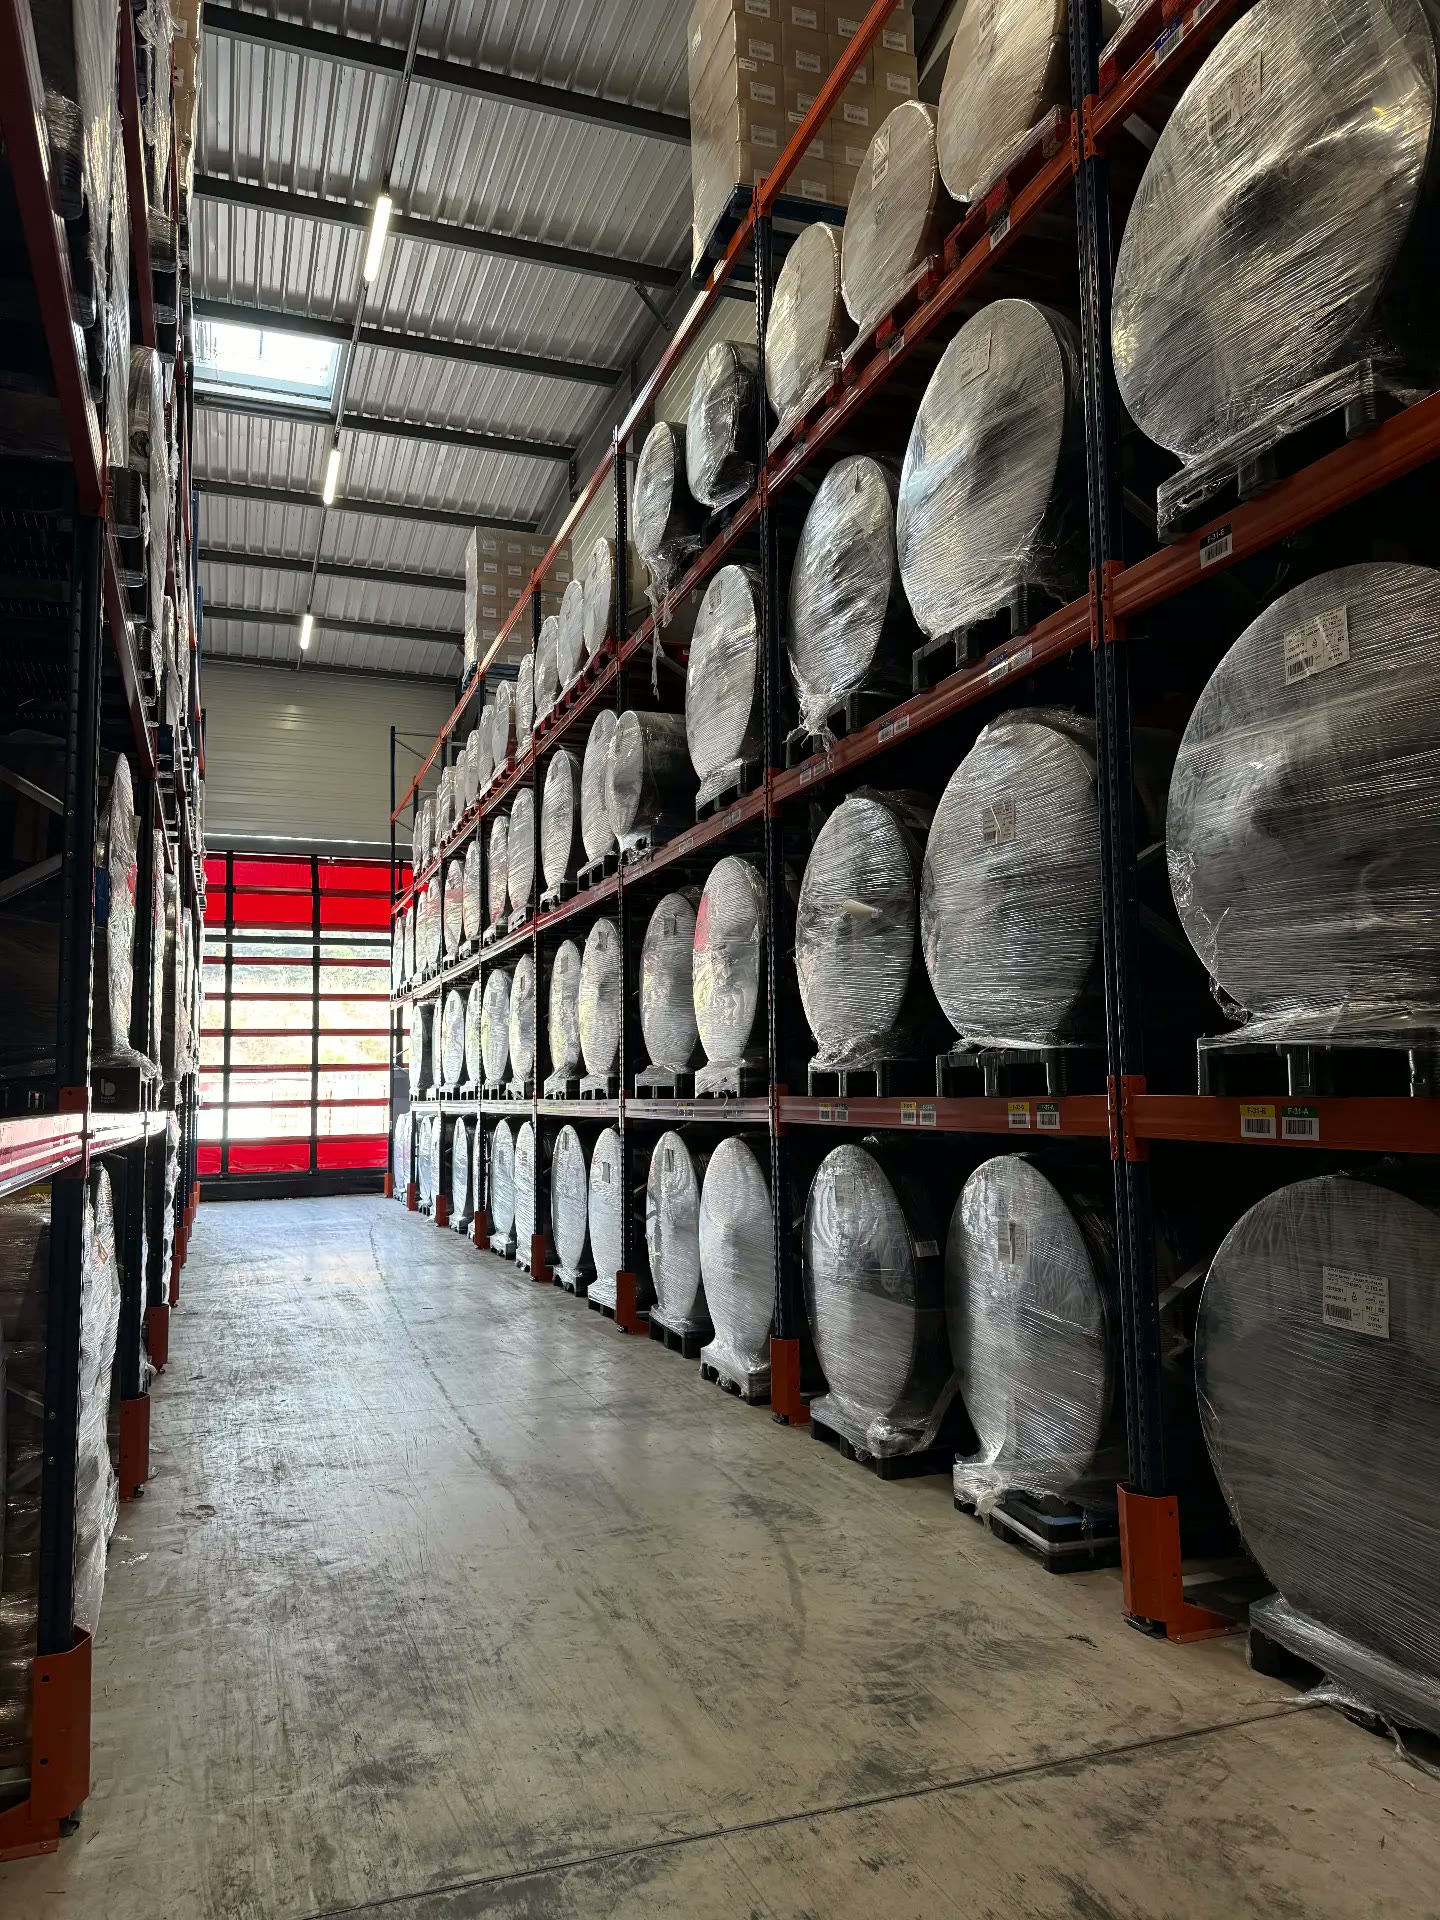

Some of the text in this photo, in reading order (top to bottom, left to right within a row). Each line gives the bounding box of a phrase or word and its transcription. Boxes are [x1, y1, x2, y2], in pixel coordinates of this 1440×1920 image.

[1207, 528, 1225, 544] F-31-E
[1247, 1106, 1267, 1115] F-31-B
[1287, 1107, 1309, 1115] F-31-A
